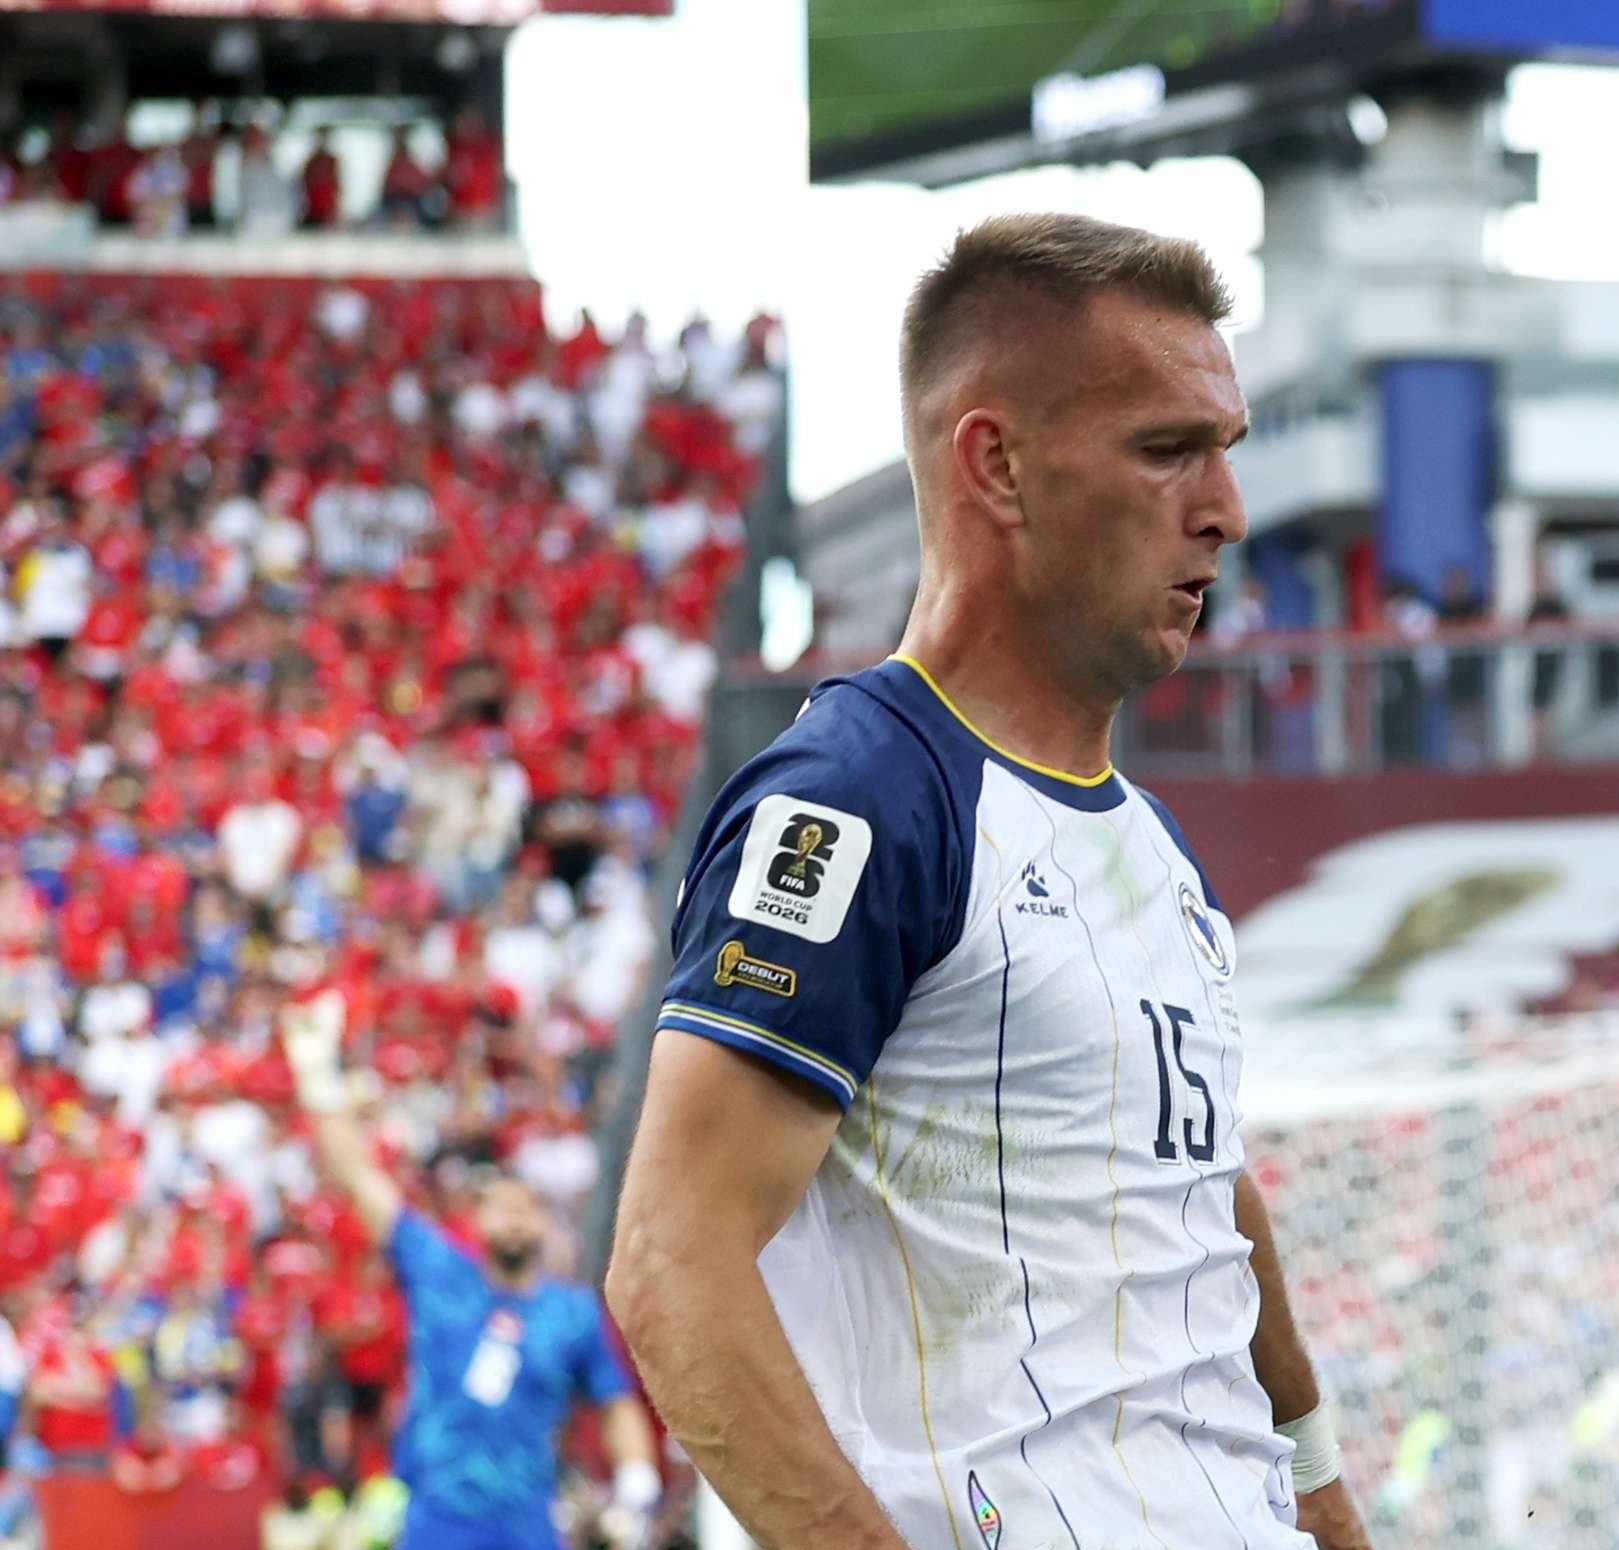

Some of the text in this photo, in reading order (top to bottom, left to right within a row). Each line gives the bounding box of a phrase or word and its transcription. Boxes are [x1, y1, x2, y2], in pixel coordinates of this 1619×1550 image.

[778, 873, 806, 892] FIFA
[753, 899, 809, 926] 2026
[759, 890, 814, 913] WORLD CUP
[1014, 902, 1070, 919] KELME
[737, 960, 790, 984] DEBUT
[1139, 997, 1218, 1165] 15
